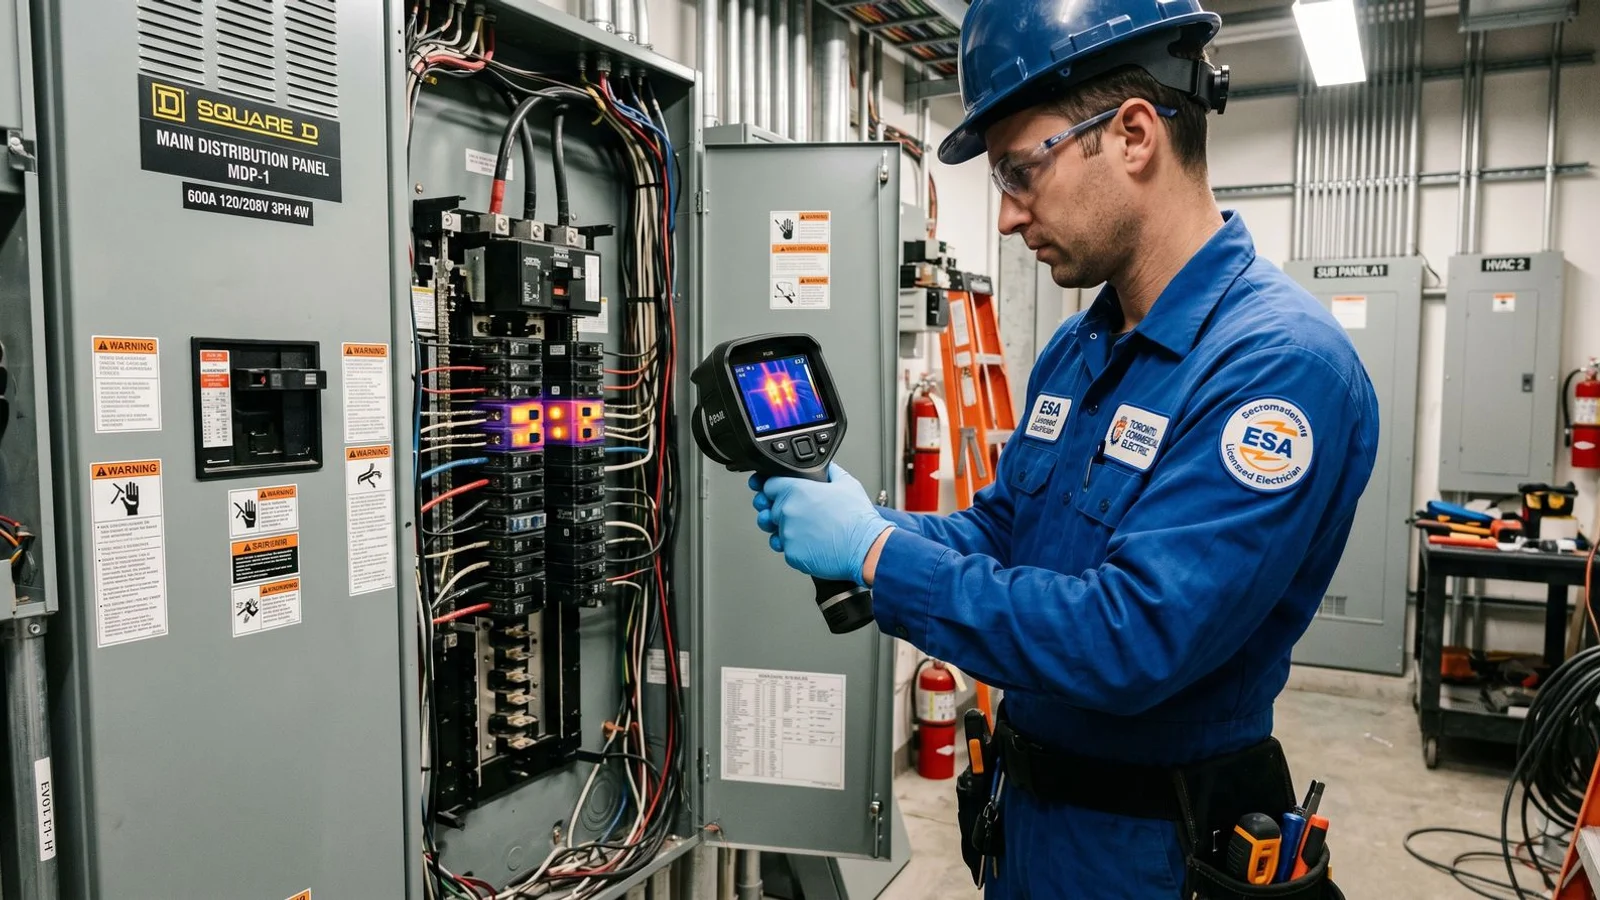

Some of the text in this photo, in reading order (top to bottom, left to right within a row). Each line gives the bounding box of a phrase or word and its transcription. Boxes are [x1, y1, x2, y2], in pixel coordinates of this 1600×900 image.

[197, 99, 318, 141] SQUARE D
[156, 128, 330, 178] MAIN DISTRIBUTION PANEL
[227, 163, 270, 185] MDP-1
[187, 189, 310, 220] 600A 120/208V 3PH 4W
[1316, 265, 1384, 278] SUB PANEL A1
[1485, 258, 1526, 271] HVAC 2
[109, 341, 154, 351] WARNING
[353, 347, 385, 355] WARNING
[1039, 400, 1062, 417] ESA
[1129, 419, 1158, 437] TORONTO
[1242, 426, 1292, 459] ESA
[356, 447, 389, 457] WARNING
[108, 463, 157, 476] WARNING
[1255, 465, 1302, 485] Electrician
[267, 488, 294, 497] WARNING
